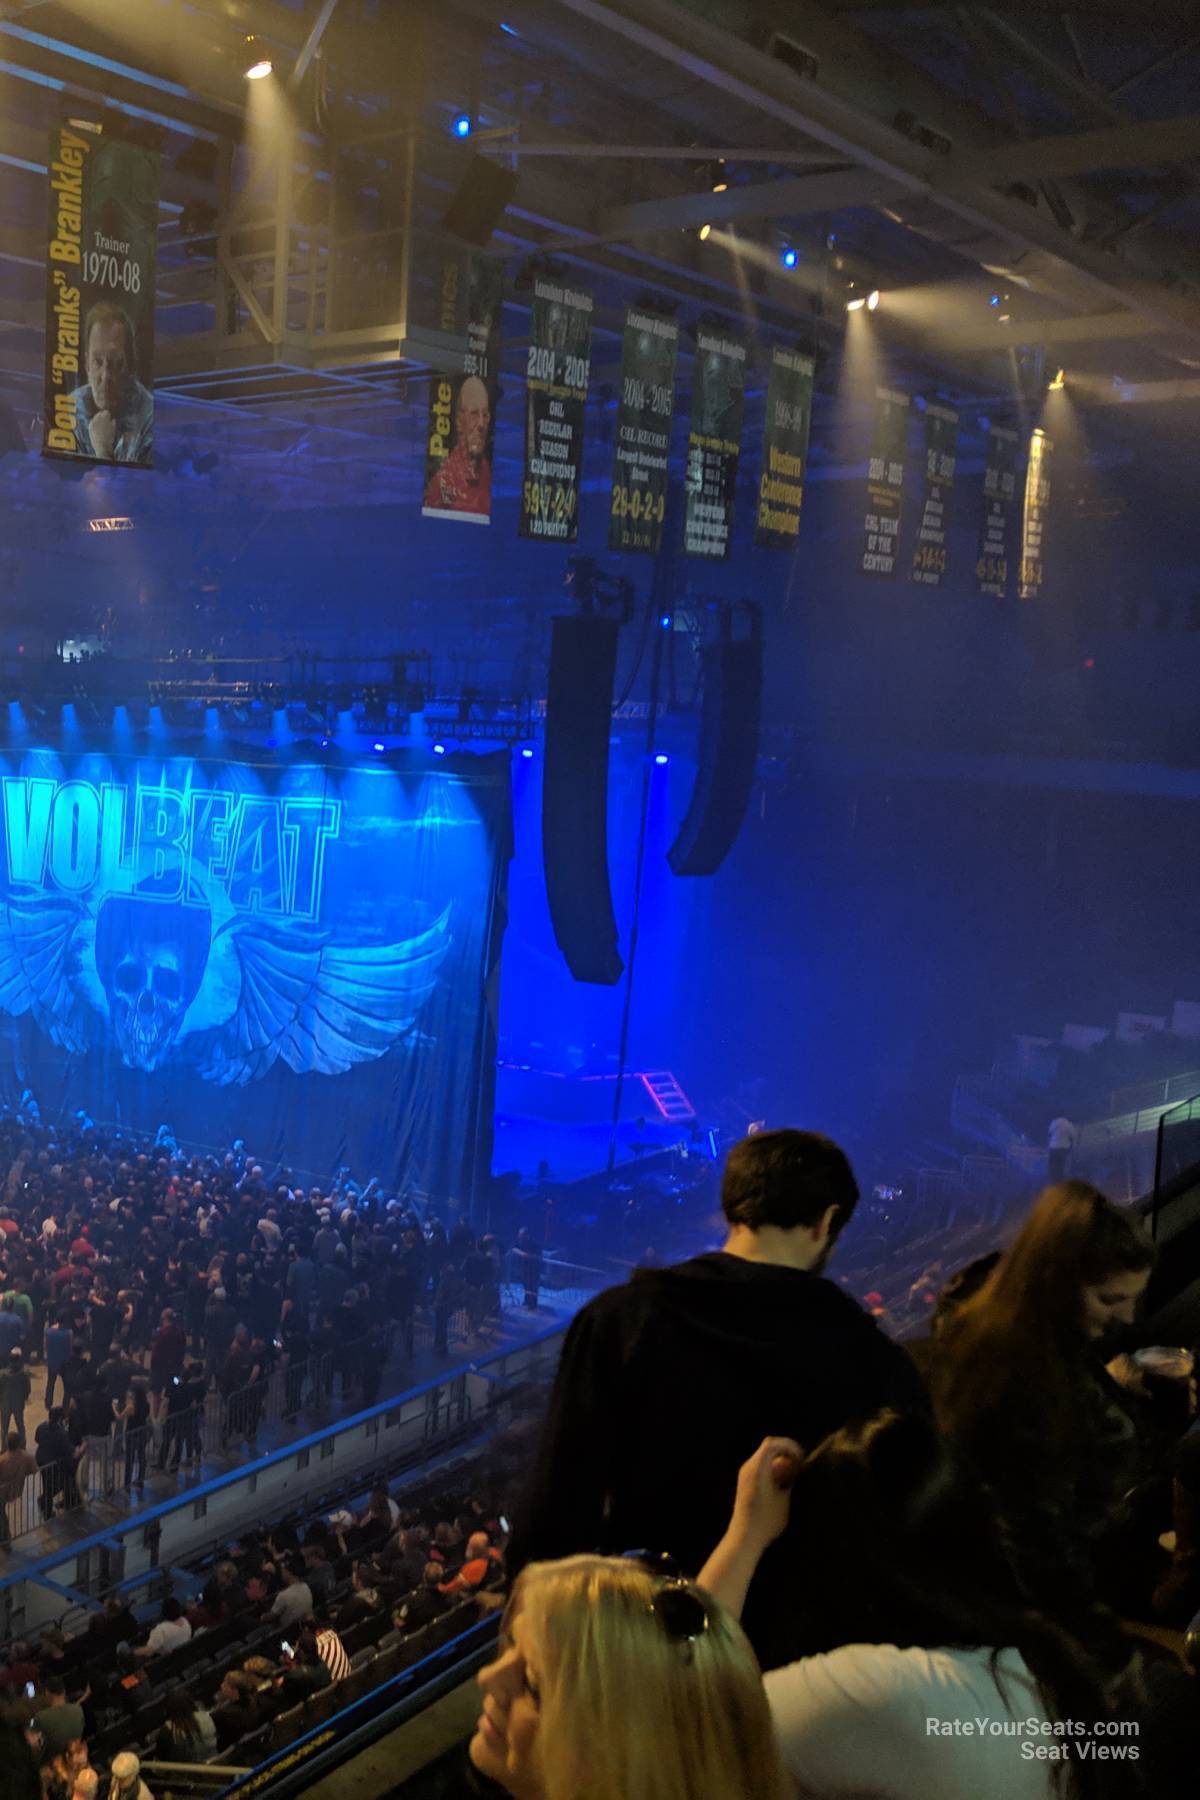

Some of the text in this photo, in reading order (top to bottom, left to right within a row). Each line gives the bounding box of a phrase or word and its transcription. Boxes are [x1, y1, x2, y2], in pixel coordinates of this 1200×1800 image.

[50, 128, 91, 265] Brankley
[94, 231, 131, 256] Trainer
[82, 250, 141, 295] 1970-08
[528, 345, 556, 384] 2004
[47, 394, 77, 451] Don
[429, 381, 453, 458] Pete
[549, 400, 565, 418] OHL
[539, 418, 573, 440] REGULAR
[540, 440, 569, 459] SEASON
[531, 459, 577, 480] CHAMPIONS
[863, 552, 895, 573] CENTURY
[2, 775, 342, 922] VOLBEAT
